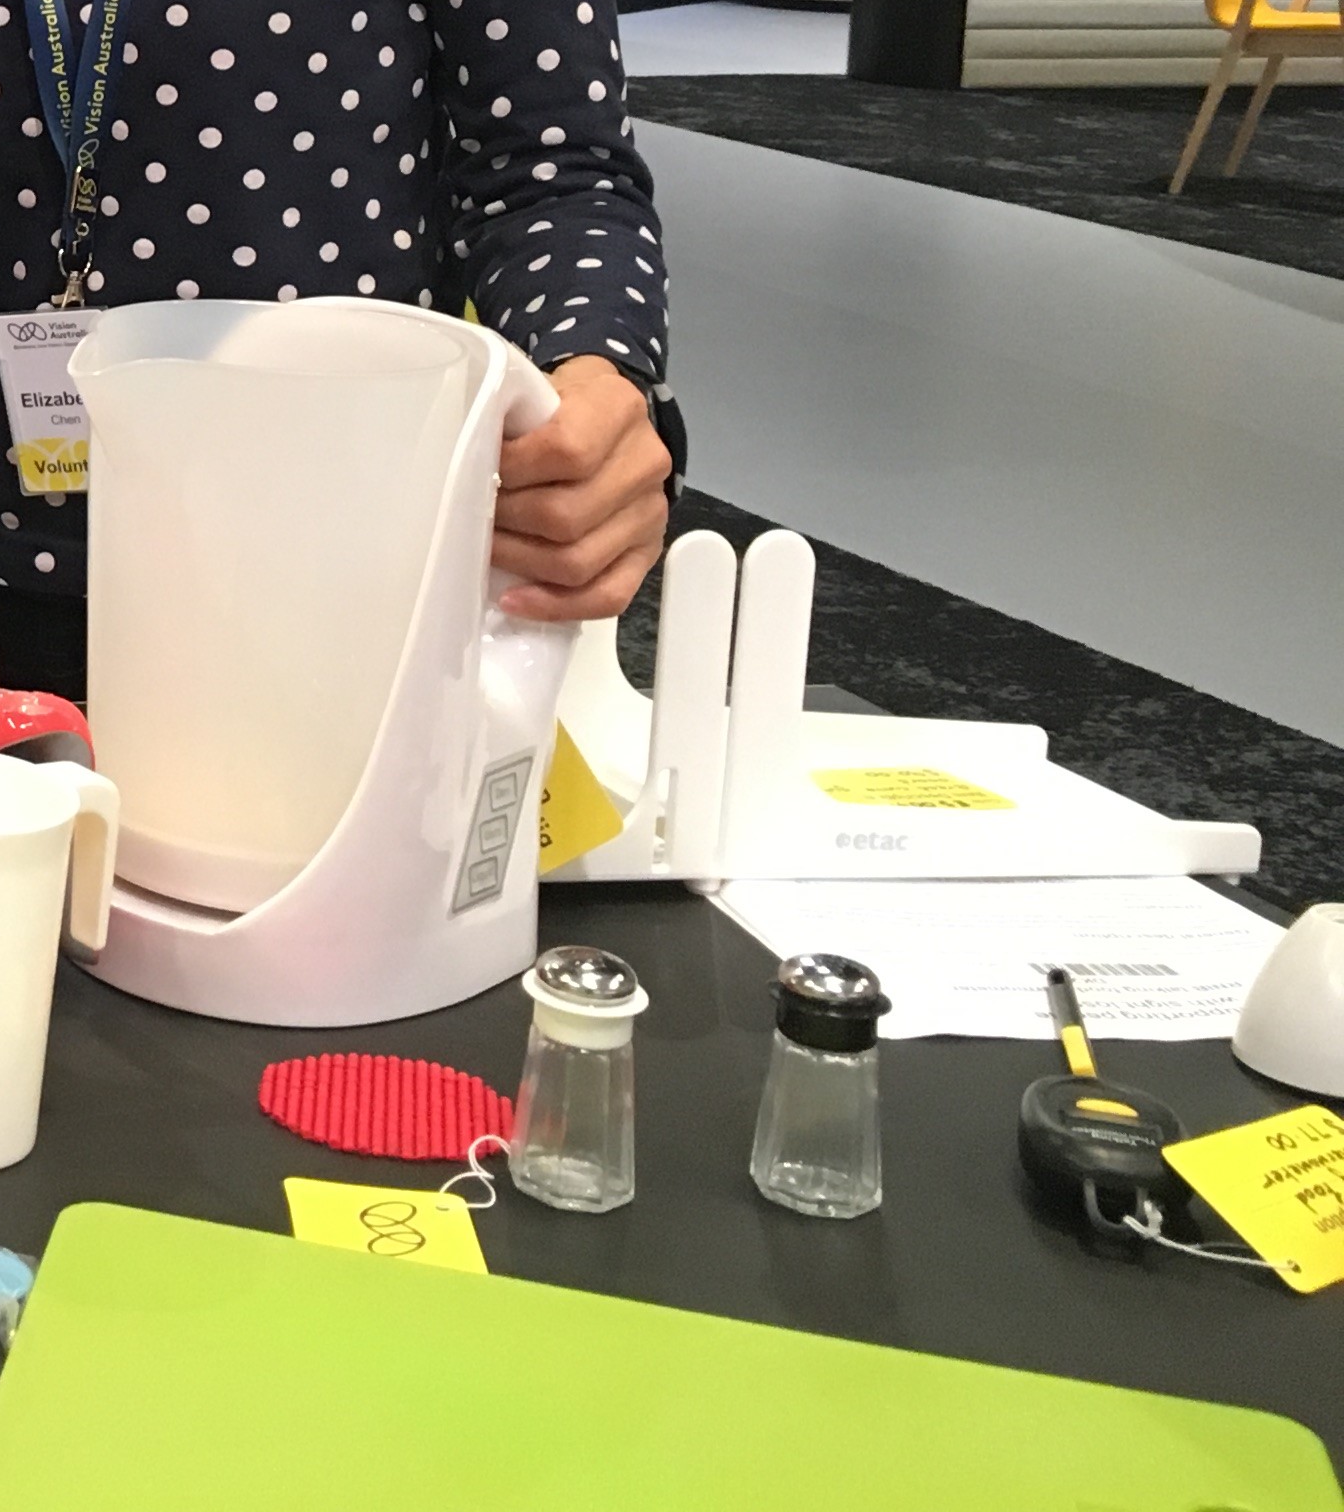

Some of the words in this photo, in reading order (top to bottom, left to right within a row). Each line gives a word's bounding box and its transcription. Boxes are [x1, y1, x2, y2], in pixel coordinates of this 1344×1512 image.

[83, 79, 107, 136] Vision
[48, 320, 77, 330] Vision
[21, 391, 84, 408] Elizabe
[50, 414, 81, 426] Chen
[34, 459, 89, 475] Volunt
